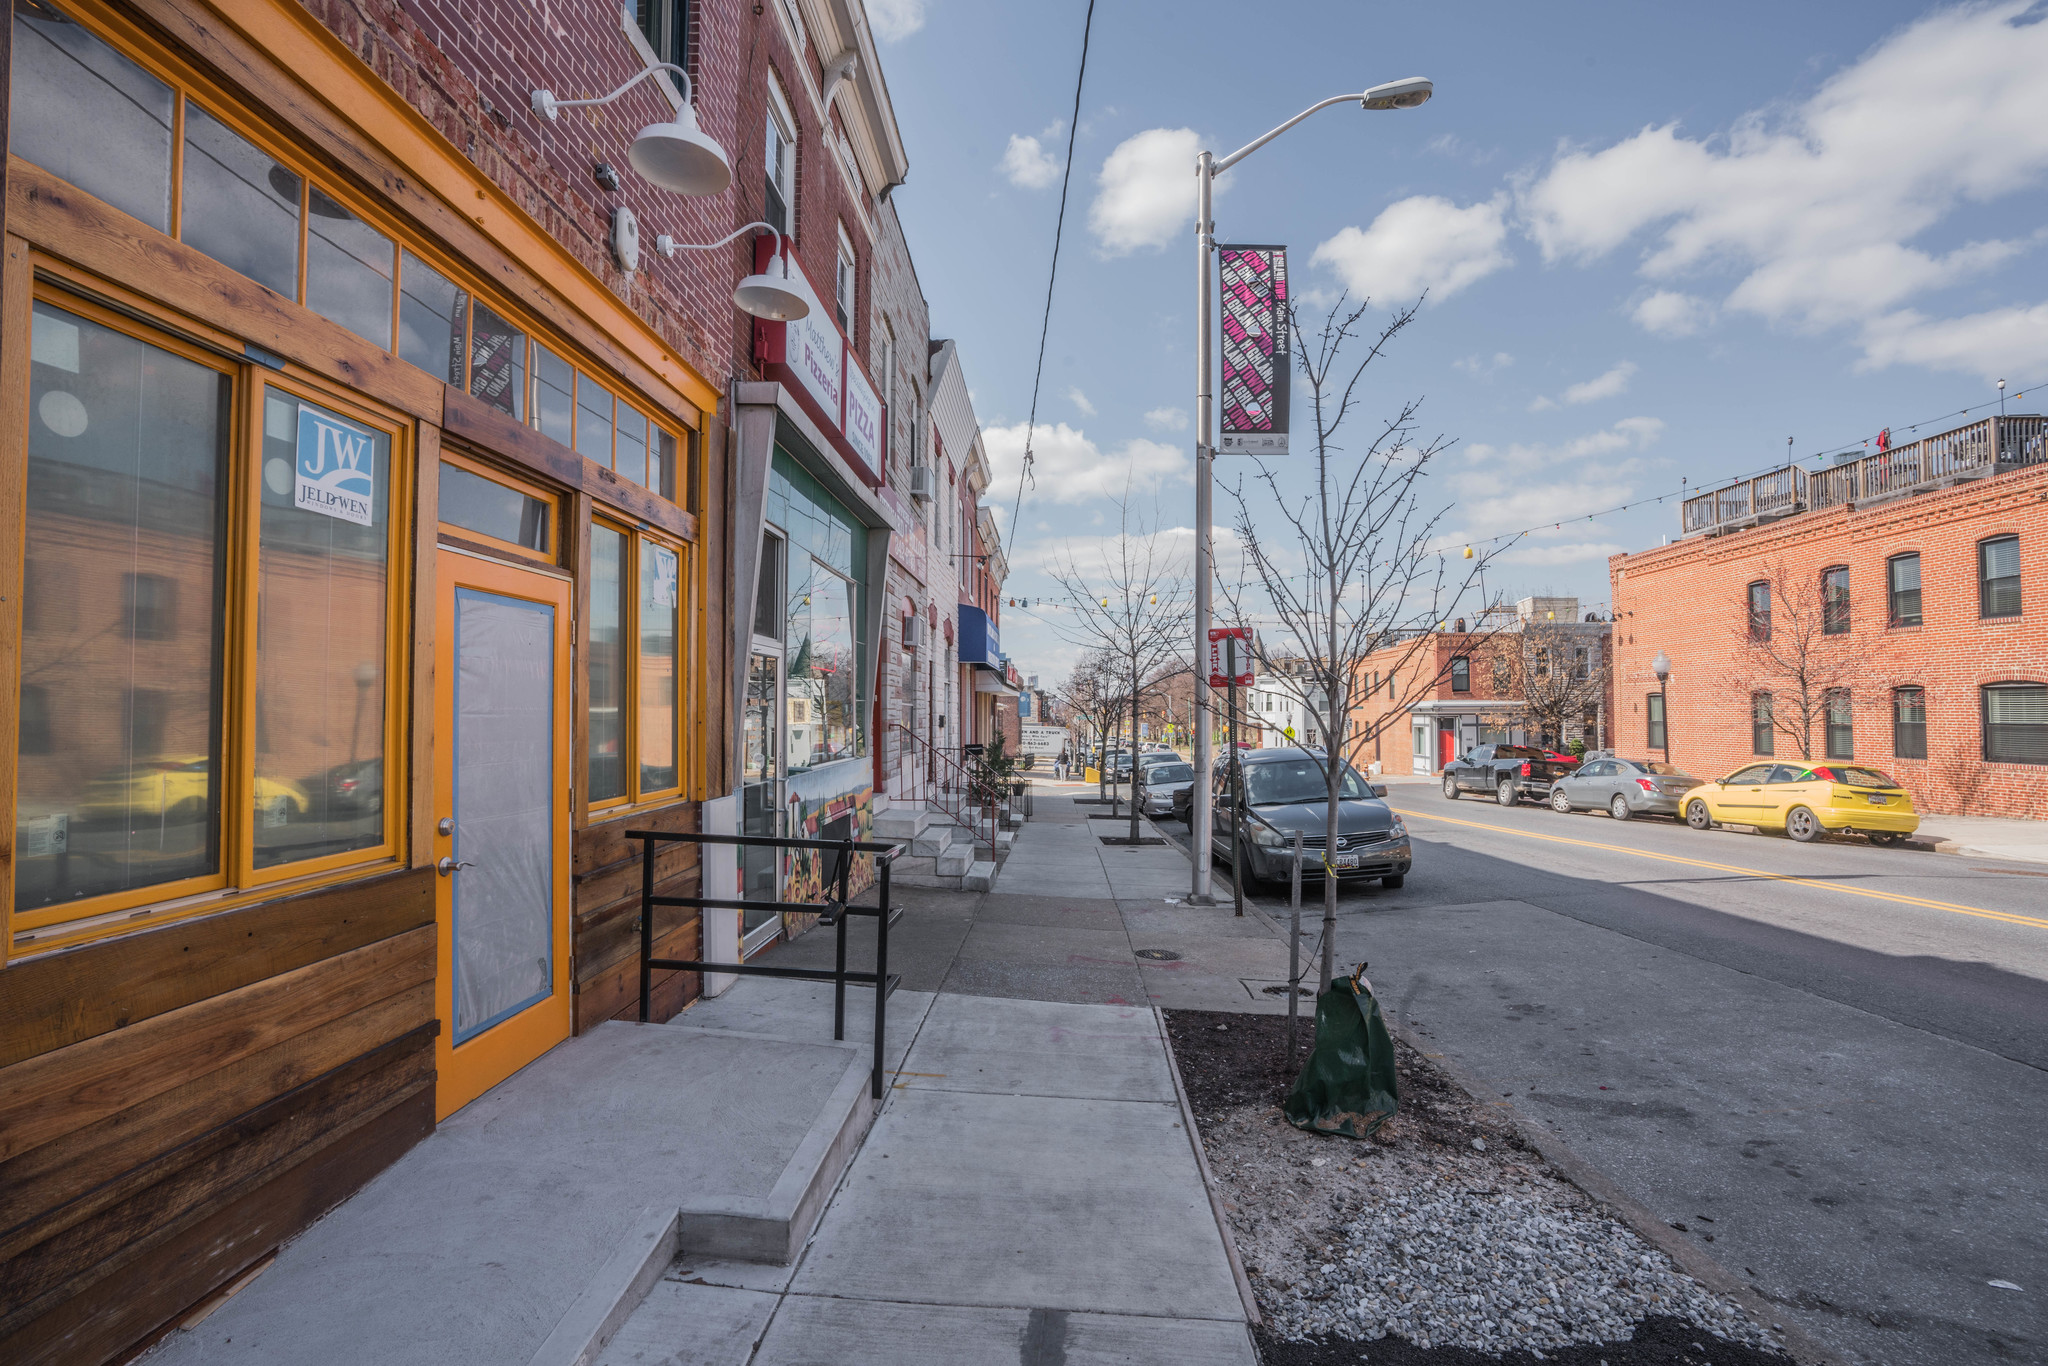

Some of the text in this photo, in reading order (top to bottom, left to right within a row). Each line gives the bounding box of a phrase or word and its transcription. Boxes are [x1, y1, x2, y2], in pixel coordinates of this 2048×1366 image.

[1275, 323, 1288, 356] Street
[804, 342, 838, 406] Pizzeria
[305, 421, 366, 474] JW
[849, 390, 875, 449] PIZZA
